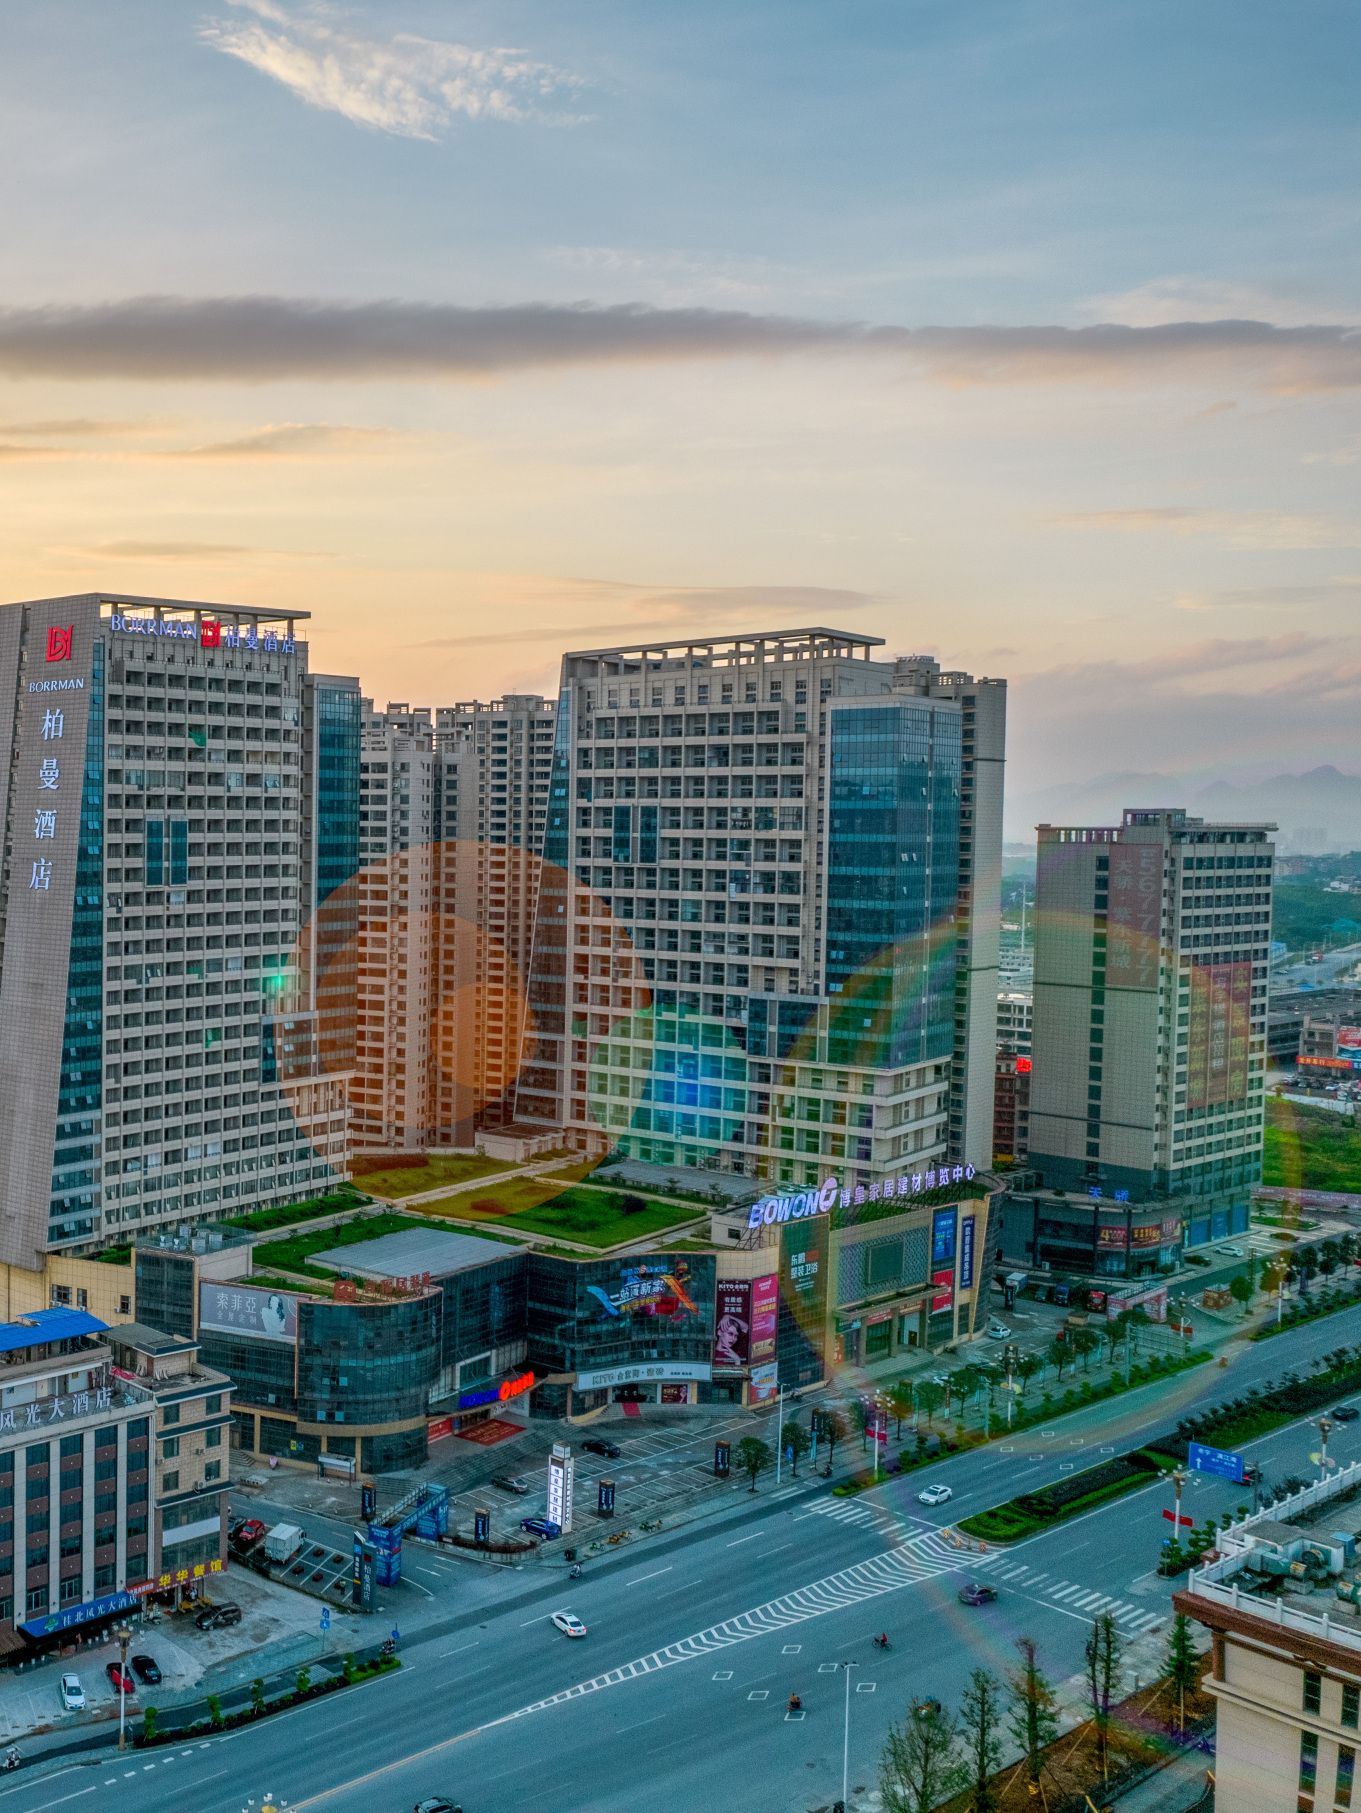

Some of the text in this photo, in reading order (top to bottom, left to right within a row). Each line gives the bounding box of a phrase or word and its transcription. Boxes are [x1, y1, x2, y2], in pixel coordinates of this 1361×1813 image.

[111, 614, 197, 639] BORRMAN
[225, 625, 296, 654] 柏曼酒店
[29, 678, 84, 693] BORRMAN
[29, 708, 65, 891] 柏曼酒店
[840, 1163, 976, 1209] 博皇家居建材博览中心
[1089, 1186, 1129, 1203] 天骄
[748, 1177, 838, 1229] BOWONG
[216, 1292, 257, 1314] 索菲亞
[217, 1311, 257, 1325] 全屋定制
[159, 1559, 222, 1587] 华华餐馆
[62, 1594, 137, 1628] 桂北风光大酒店
